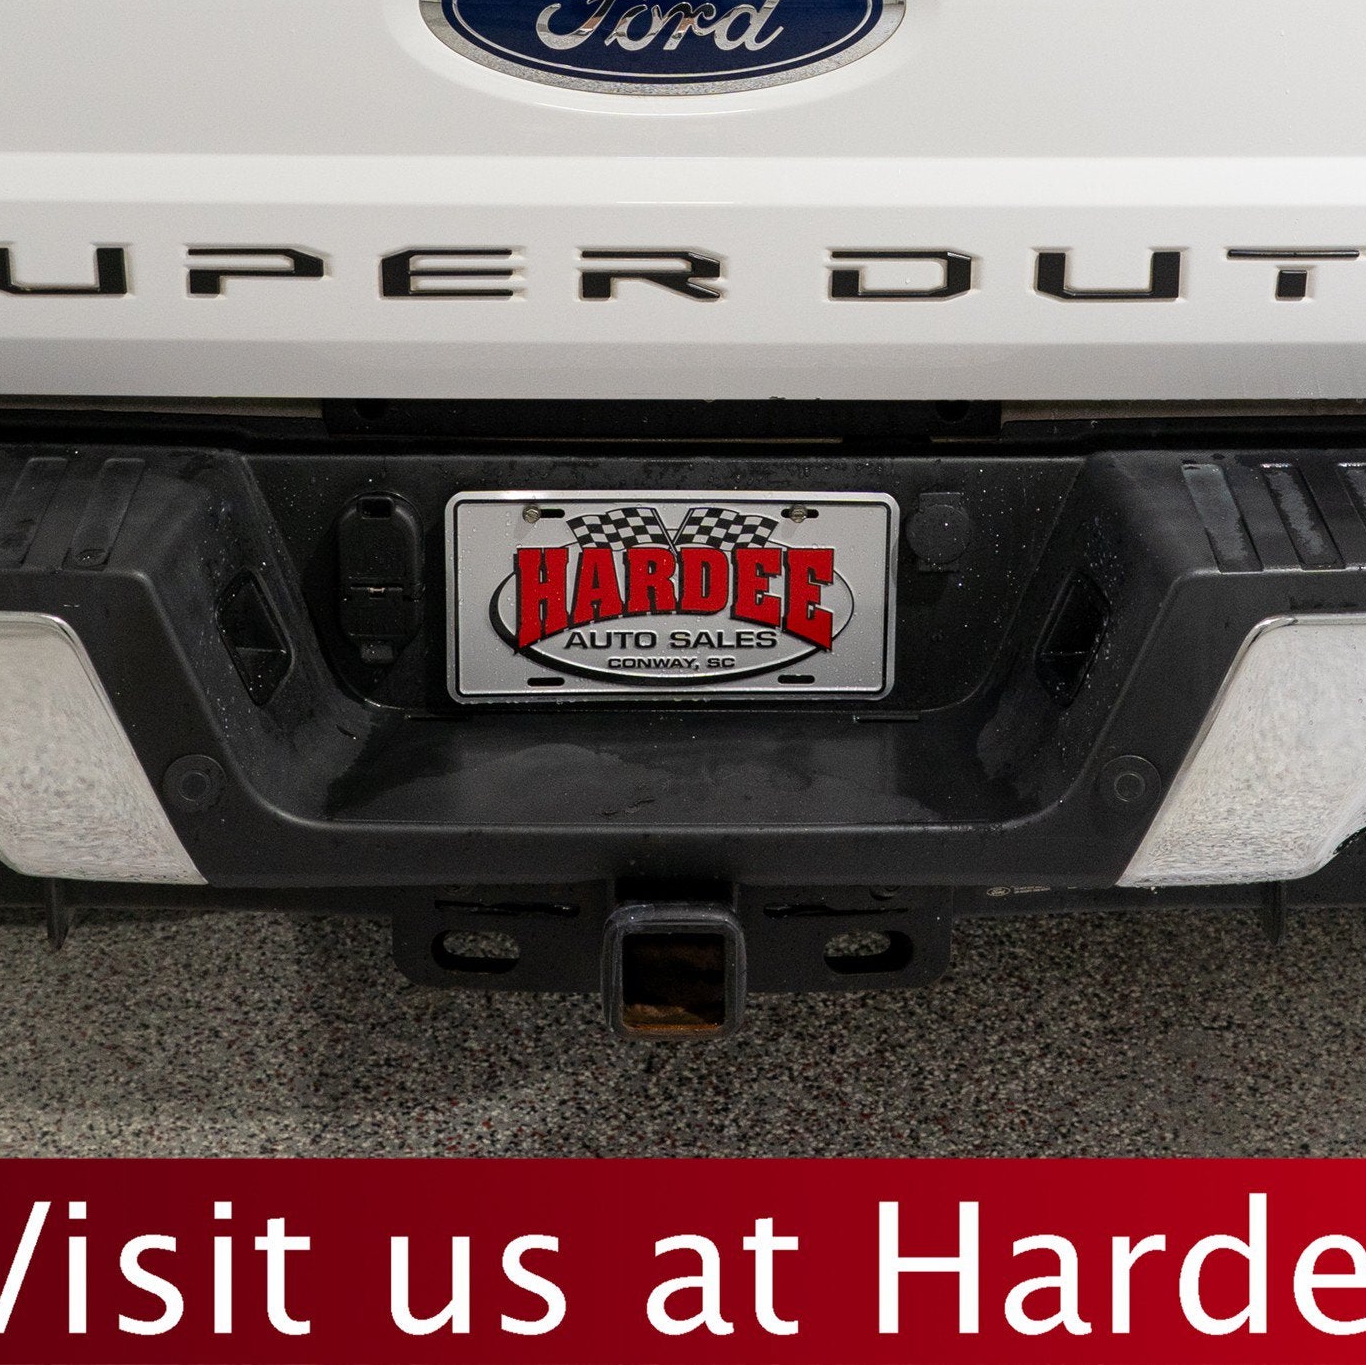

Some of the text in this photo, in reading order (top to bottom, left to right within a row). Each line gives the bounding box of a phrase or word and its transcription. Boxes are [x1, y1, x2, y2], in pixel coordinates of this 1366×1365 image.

[515, 547, 835, 653] HARDEE
[563, 629, 778, 651] AUTO SALES
[607, 656, 736, 672] CONWAY, SC
